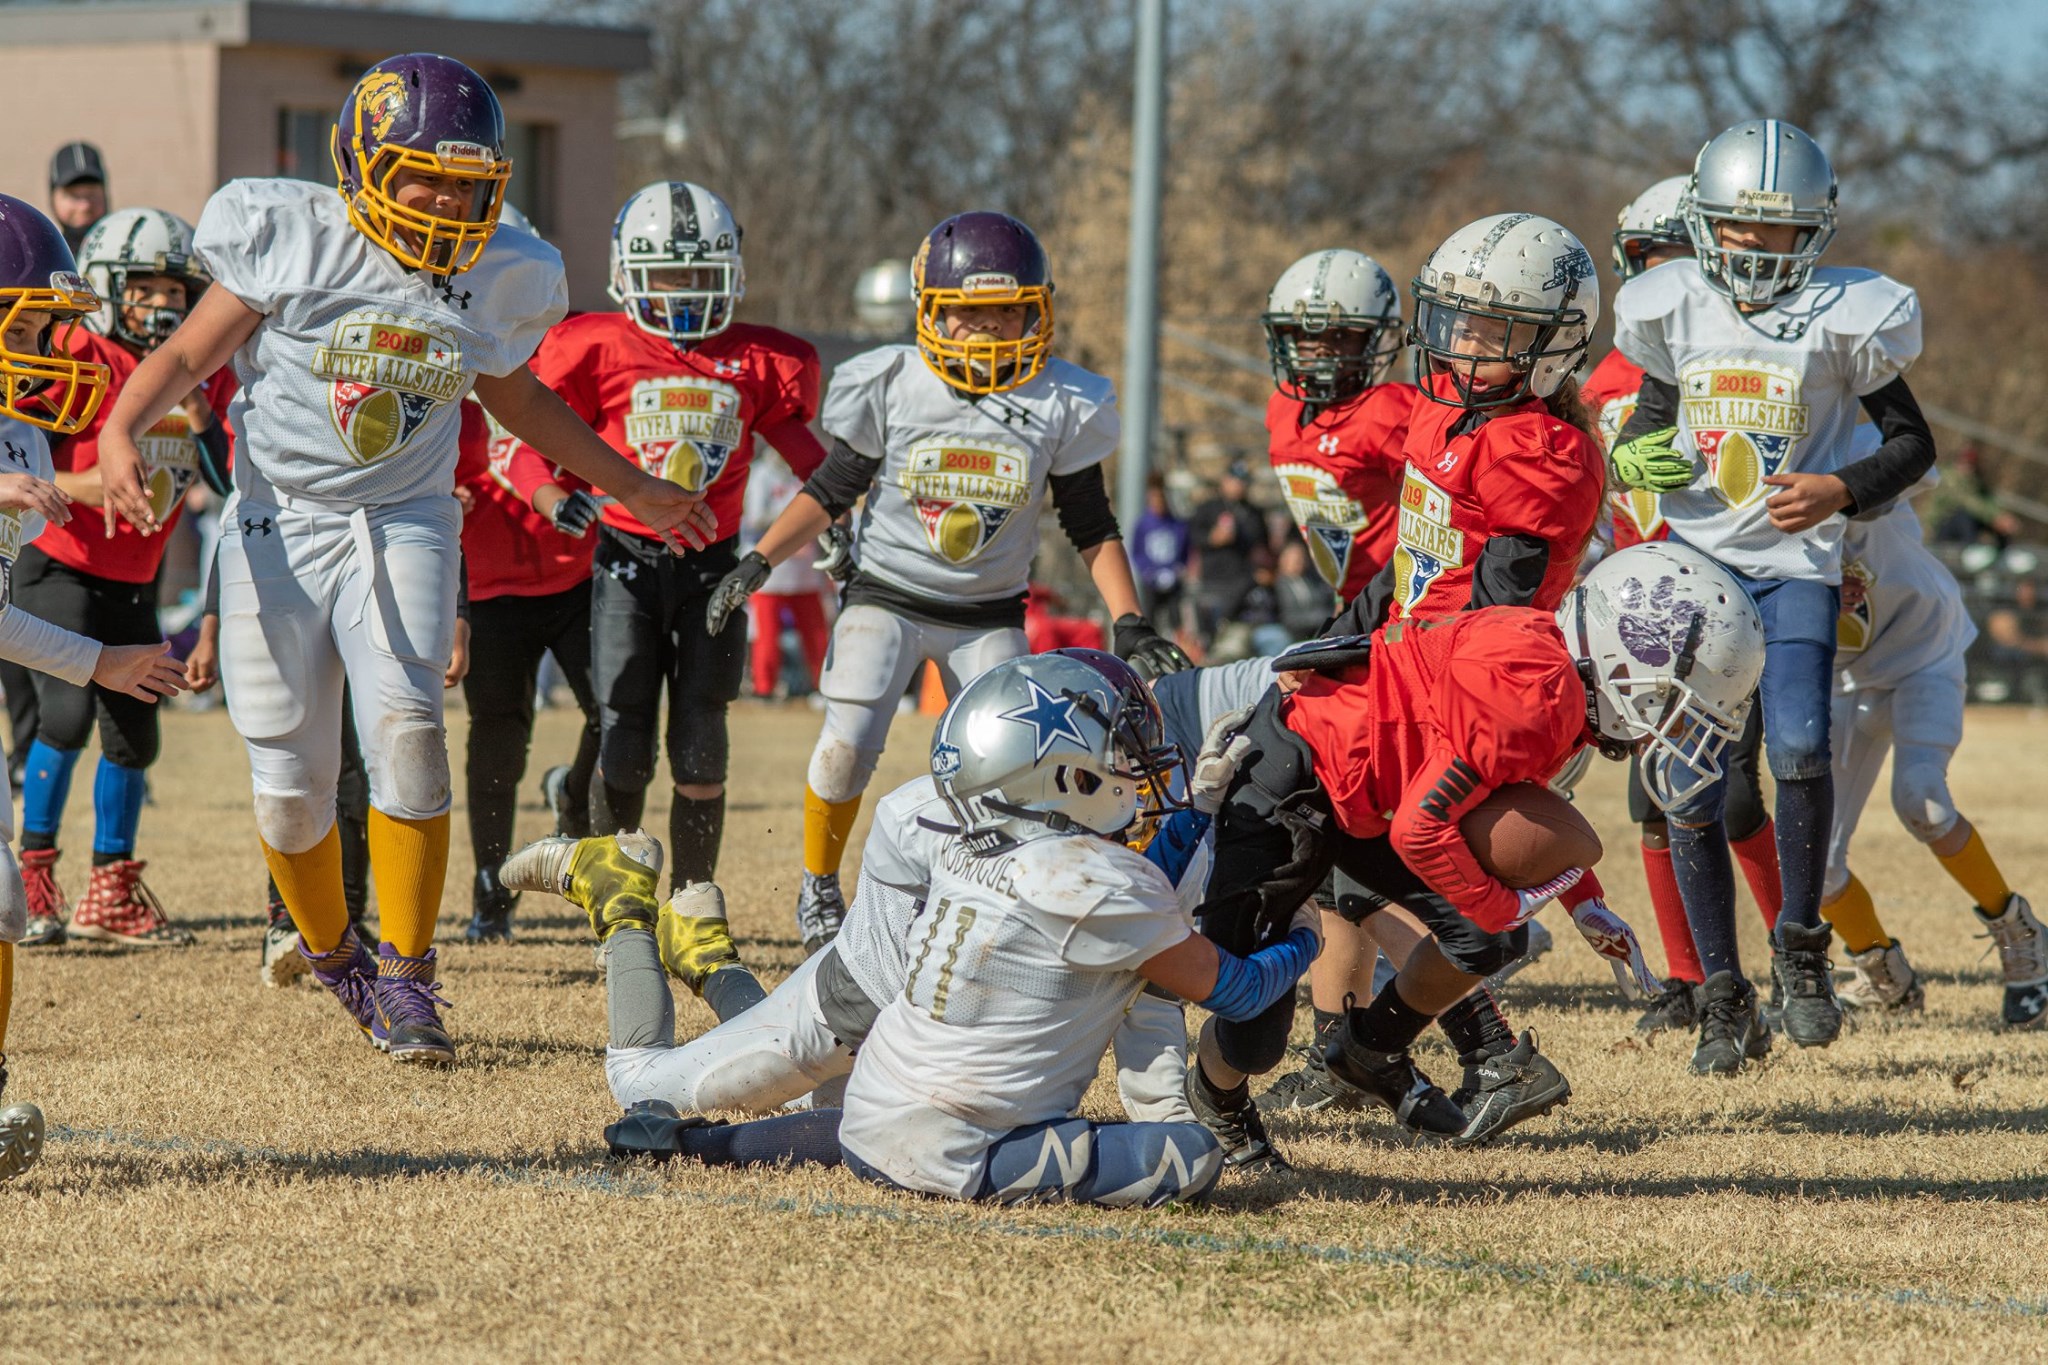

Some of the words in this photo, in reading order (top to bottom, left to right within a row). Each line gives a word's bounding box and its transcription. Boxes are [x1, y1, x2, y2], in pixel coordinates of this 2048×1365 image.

[451, 144, 481, 157] Riddell
[1752, 192, 1778, 202] SCHUTT
[375, 329, 424, 355] 2019
[322, 351, 379, 383] WTYFA
[381, 357, 463, 399] ALLSTARS
[1716, 375, 1762, 394] 2019
[665, 391, 709, 408] 2019
[628, 414, 673, 438] WTYFA
[678, 414, 740, 441] ALLSTARS
[1727, 401, 1806, 432] ALLSTARS
[945, 452, 992, 471] 2019
[955, 475, 1032, 506] ALLSTARS
[905, 897, 977, 1022] 11
[1474, 1068, 1501, 1080] ALPHA
